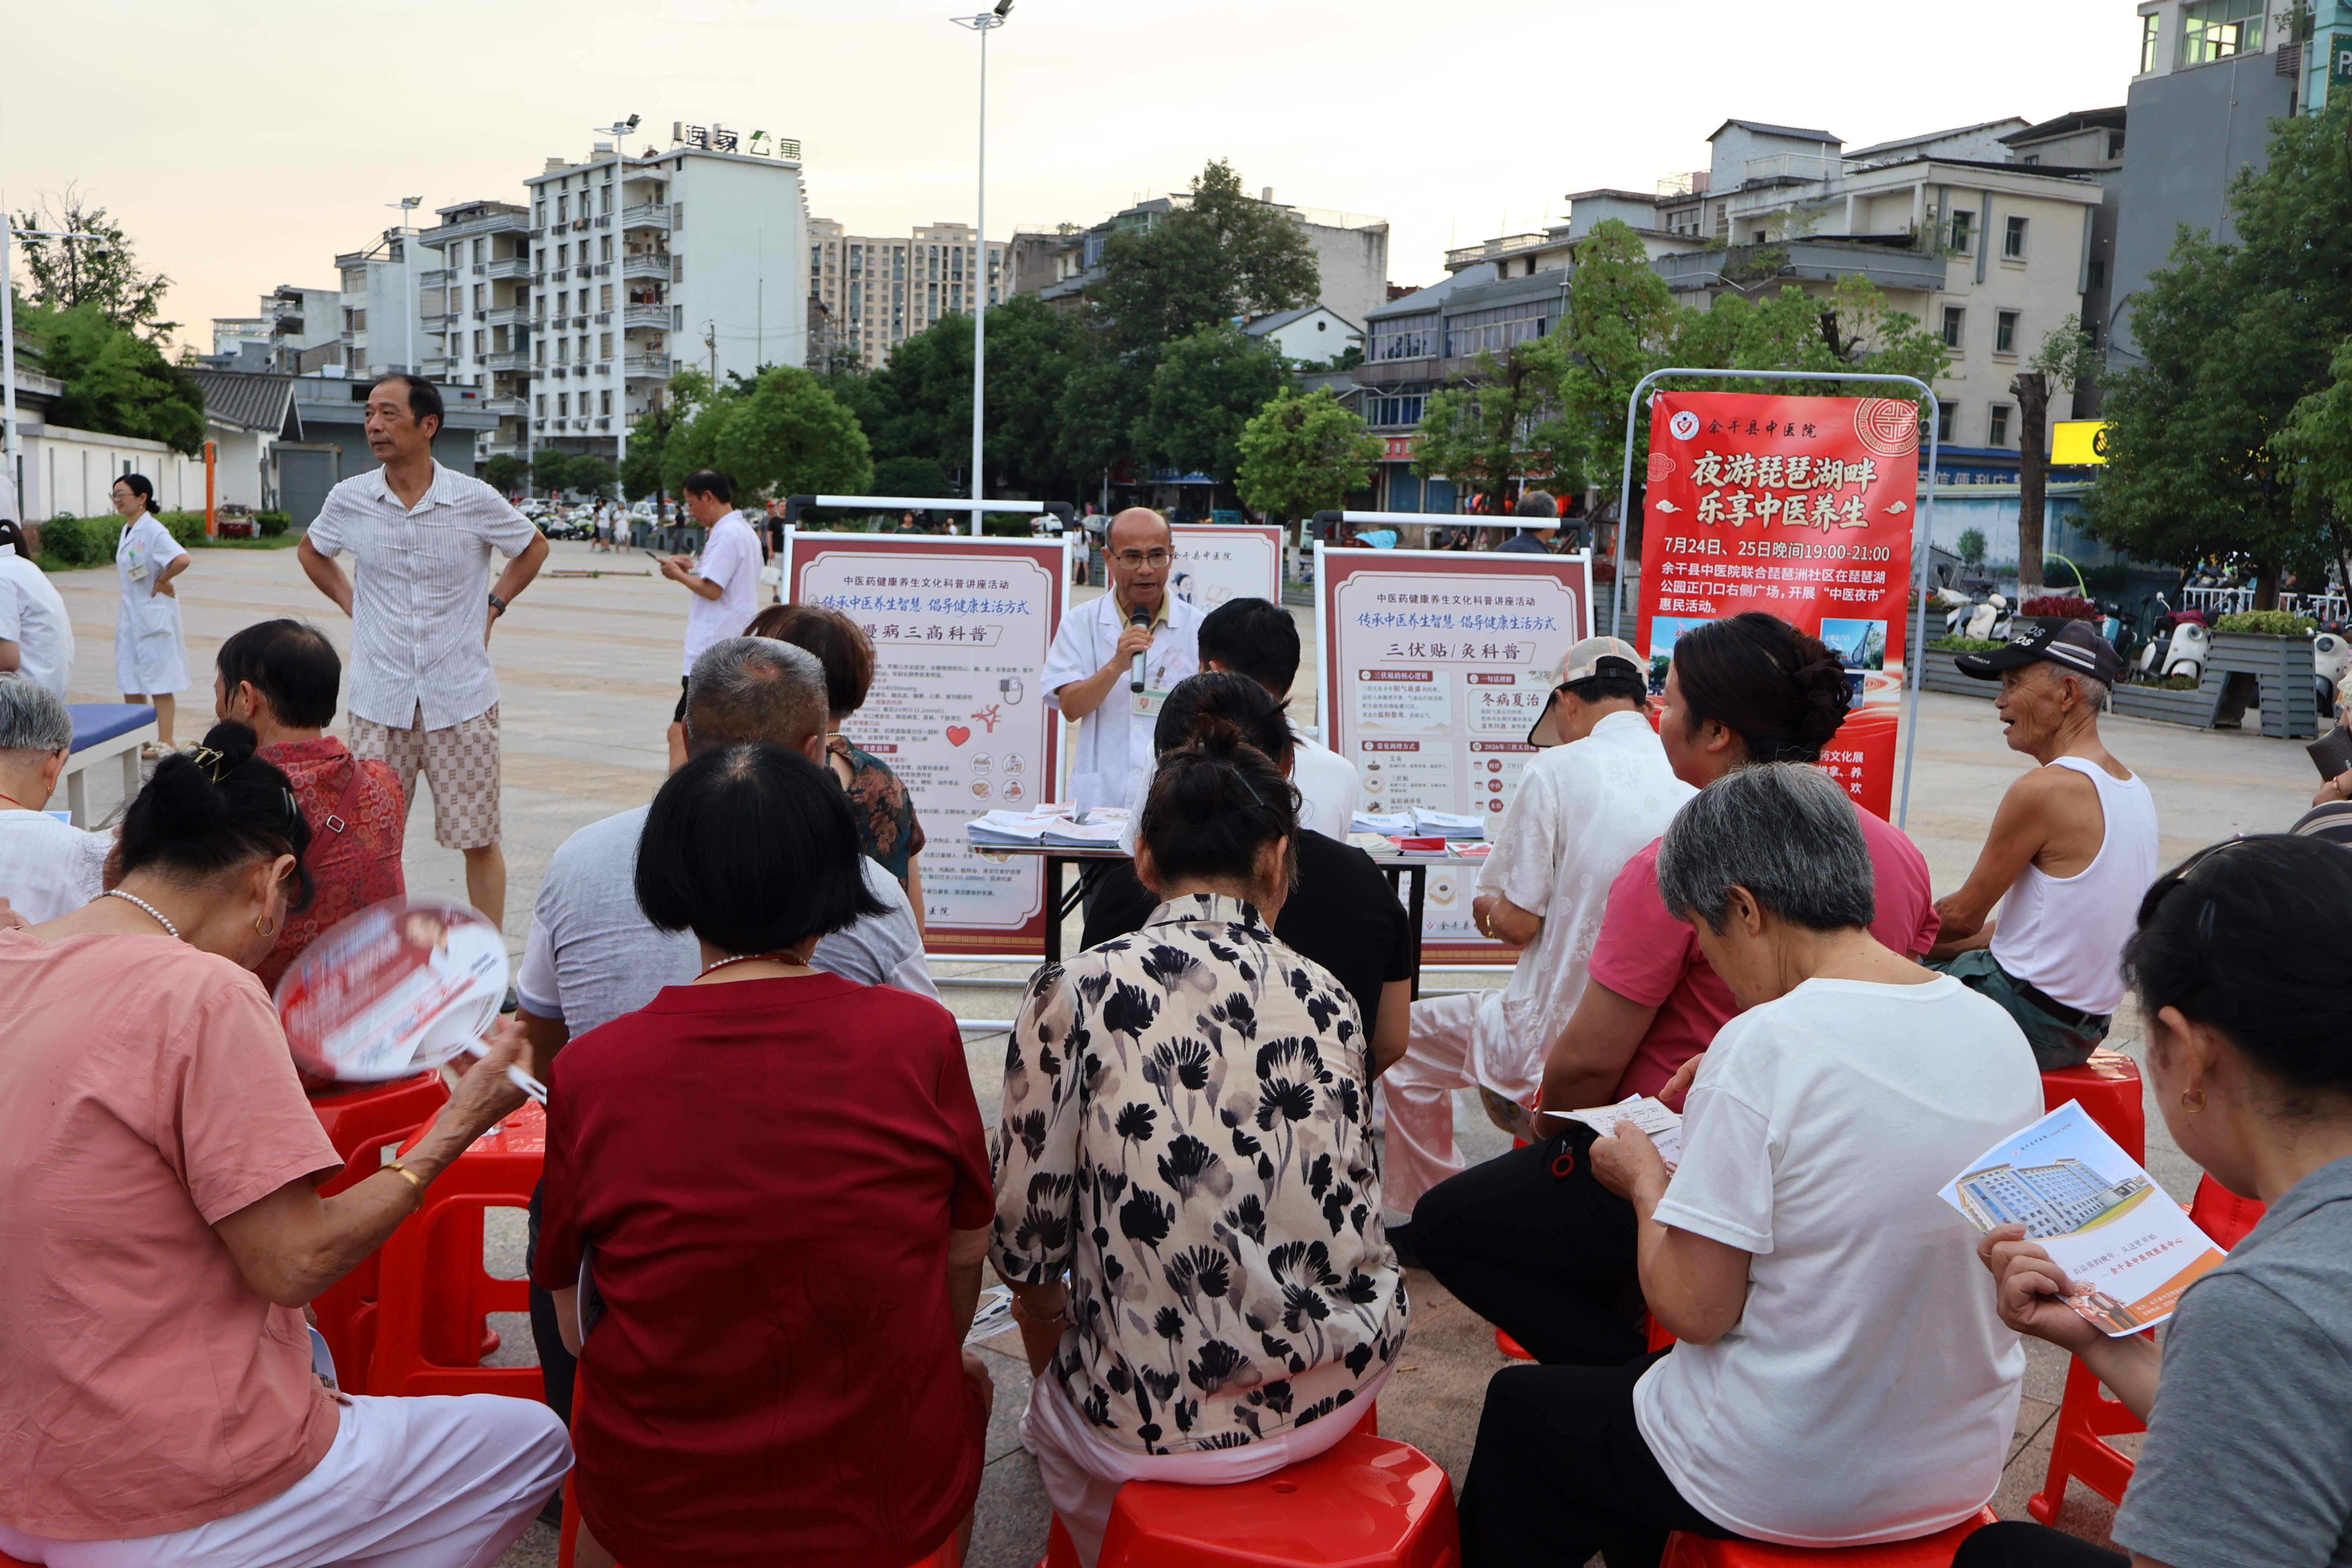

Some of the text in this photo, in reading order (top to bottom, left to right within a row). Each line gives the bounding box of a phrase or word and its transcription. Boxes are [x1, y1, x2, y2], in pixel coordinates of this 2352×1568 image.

[2338, 50, 2352, 75] P
[1708, 419, 1817, 438] 余干县中医院
[1689, 450, 1877, 495] 夜游琵琶湖畔
[1697, 490, 1869, 534] 乐享中医养生
[1661, 561, 1886, 584] 余干县中医院联合琵琶洲社区在琵琶湖
[844, 575, 1010, 590] 中医药健康养生文化科普讲座活动
[822, 595, 1033, 616] 传承中医养生智慧 倡导健康生活方式
[1377, 593, 1535, 607] 中医药健康养生文化科普讲座活动
[1659, 598, 1717, 614] 惠民活动。
[1356, 612, 1560, 632] 传承中医养生智慧 倡导健康生活方式
[863, 624, 987, 642] 慢病三高科普
[1387, 642, 1520, 660] 三伏贴/灸科普
[1481, 675, 1512, 683] 一句话理解
[1481, 692, 1540, 707] 冬病夏治
[1377, 742, 1416, 750] 常见调理方式
[1850, 782, 1862, 794] 欢
[1440, 920, 1477, 930] 余干县
